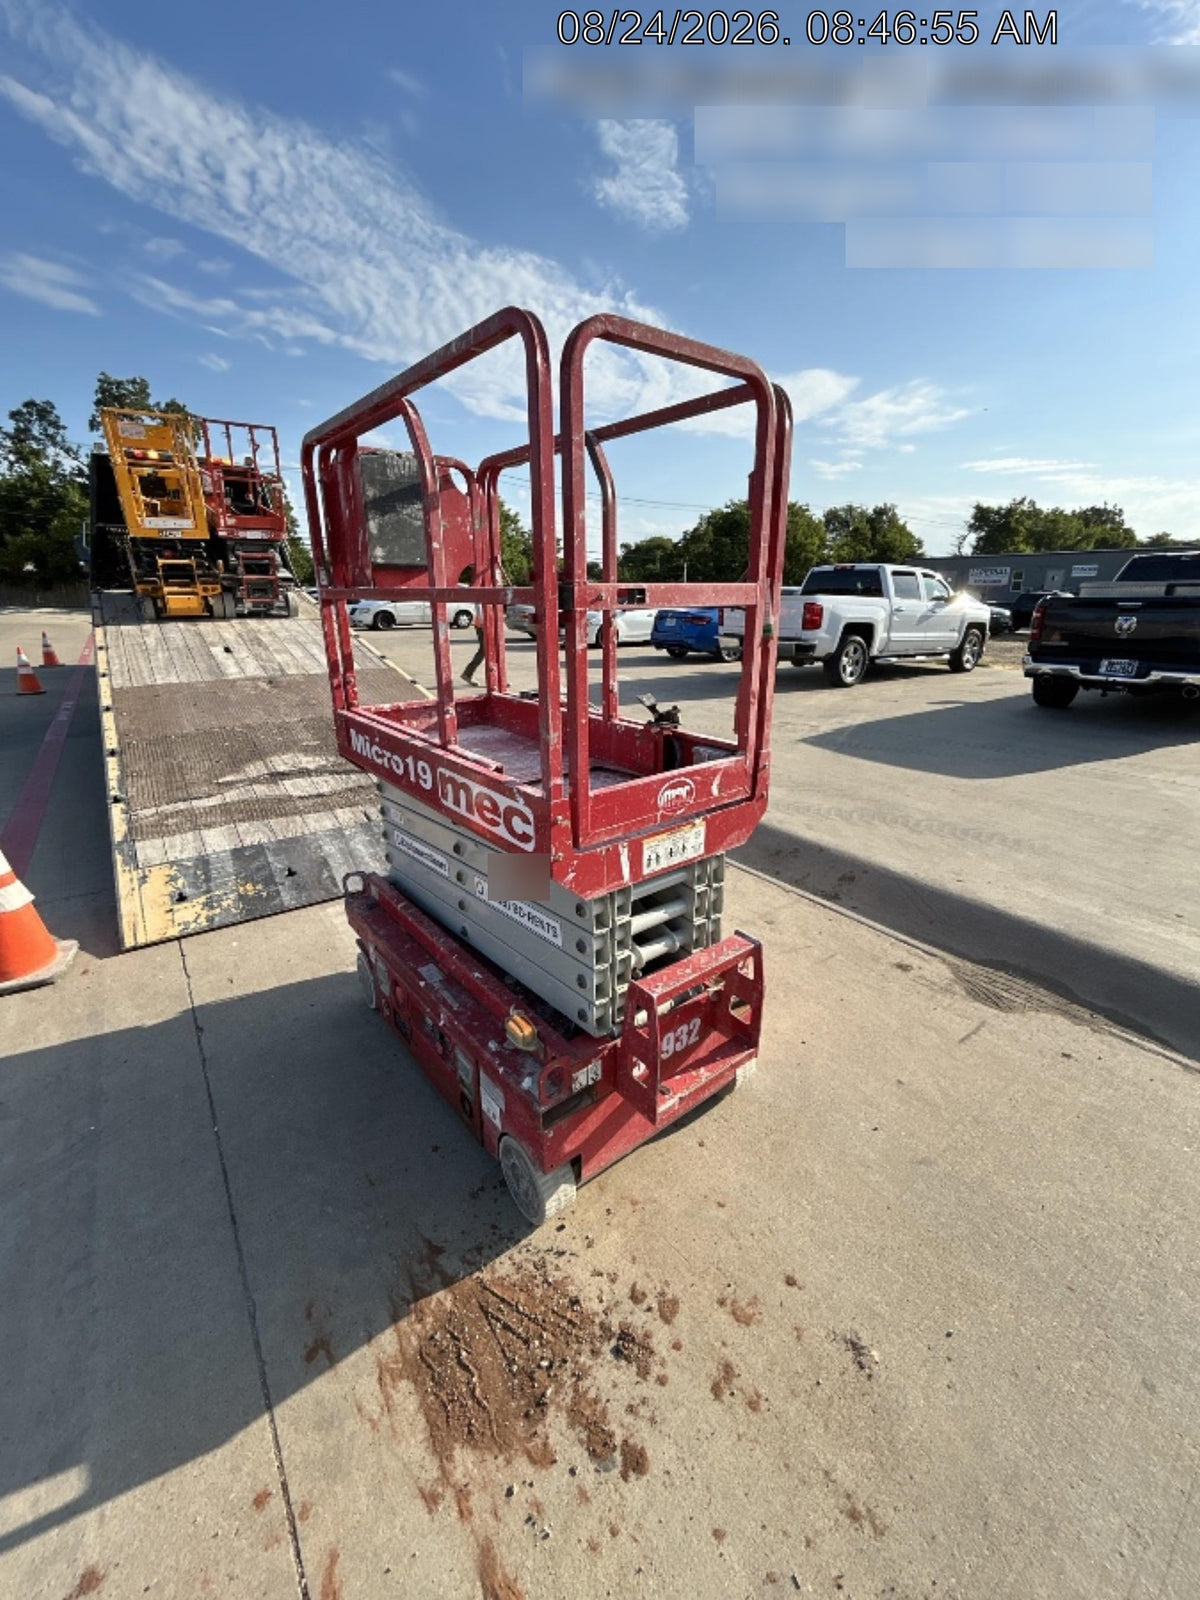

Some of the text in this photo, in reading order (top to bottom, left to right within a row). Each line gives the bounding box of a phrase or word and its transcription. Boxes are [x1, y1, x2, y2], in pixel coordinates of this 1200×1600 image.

[350, 728, 534, 843] Micro19 mec
[660, 1017, 702, 1061] 932
